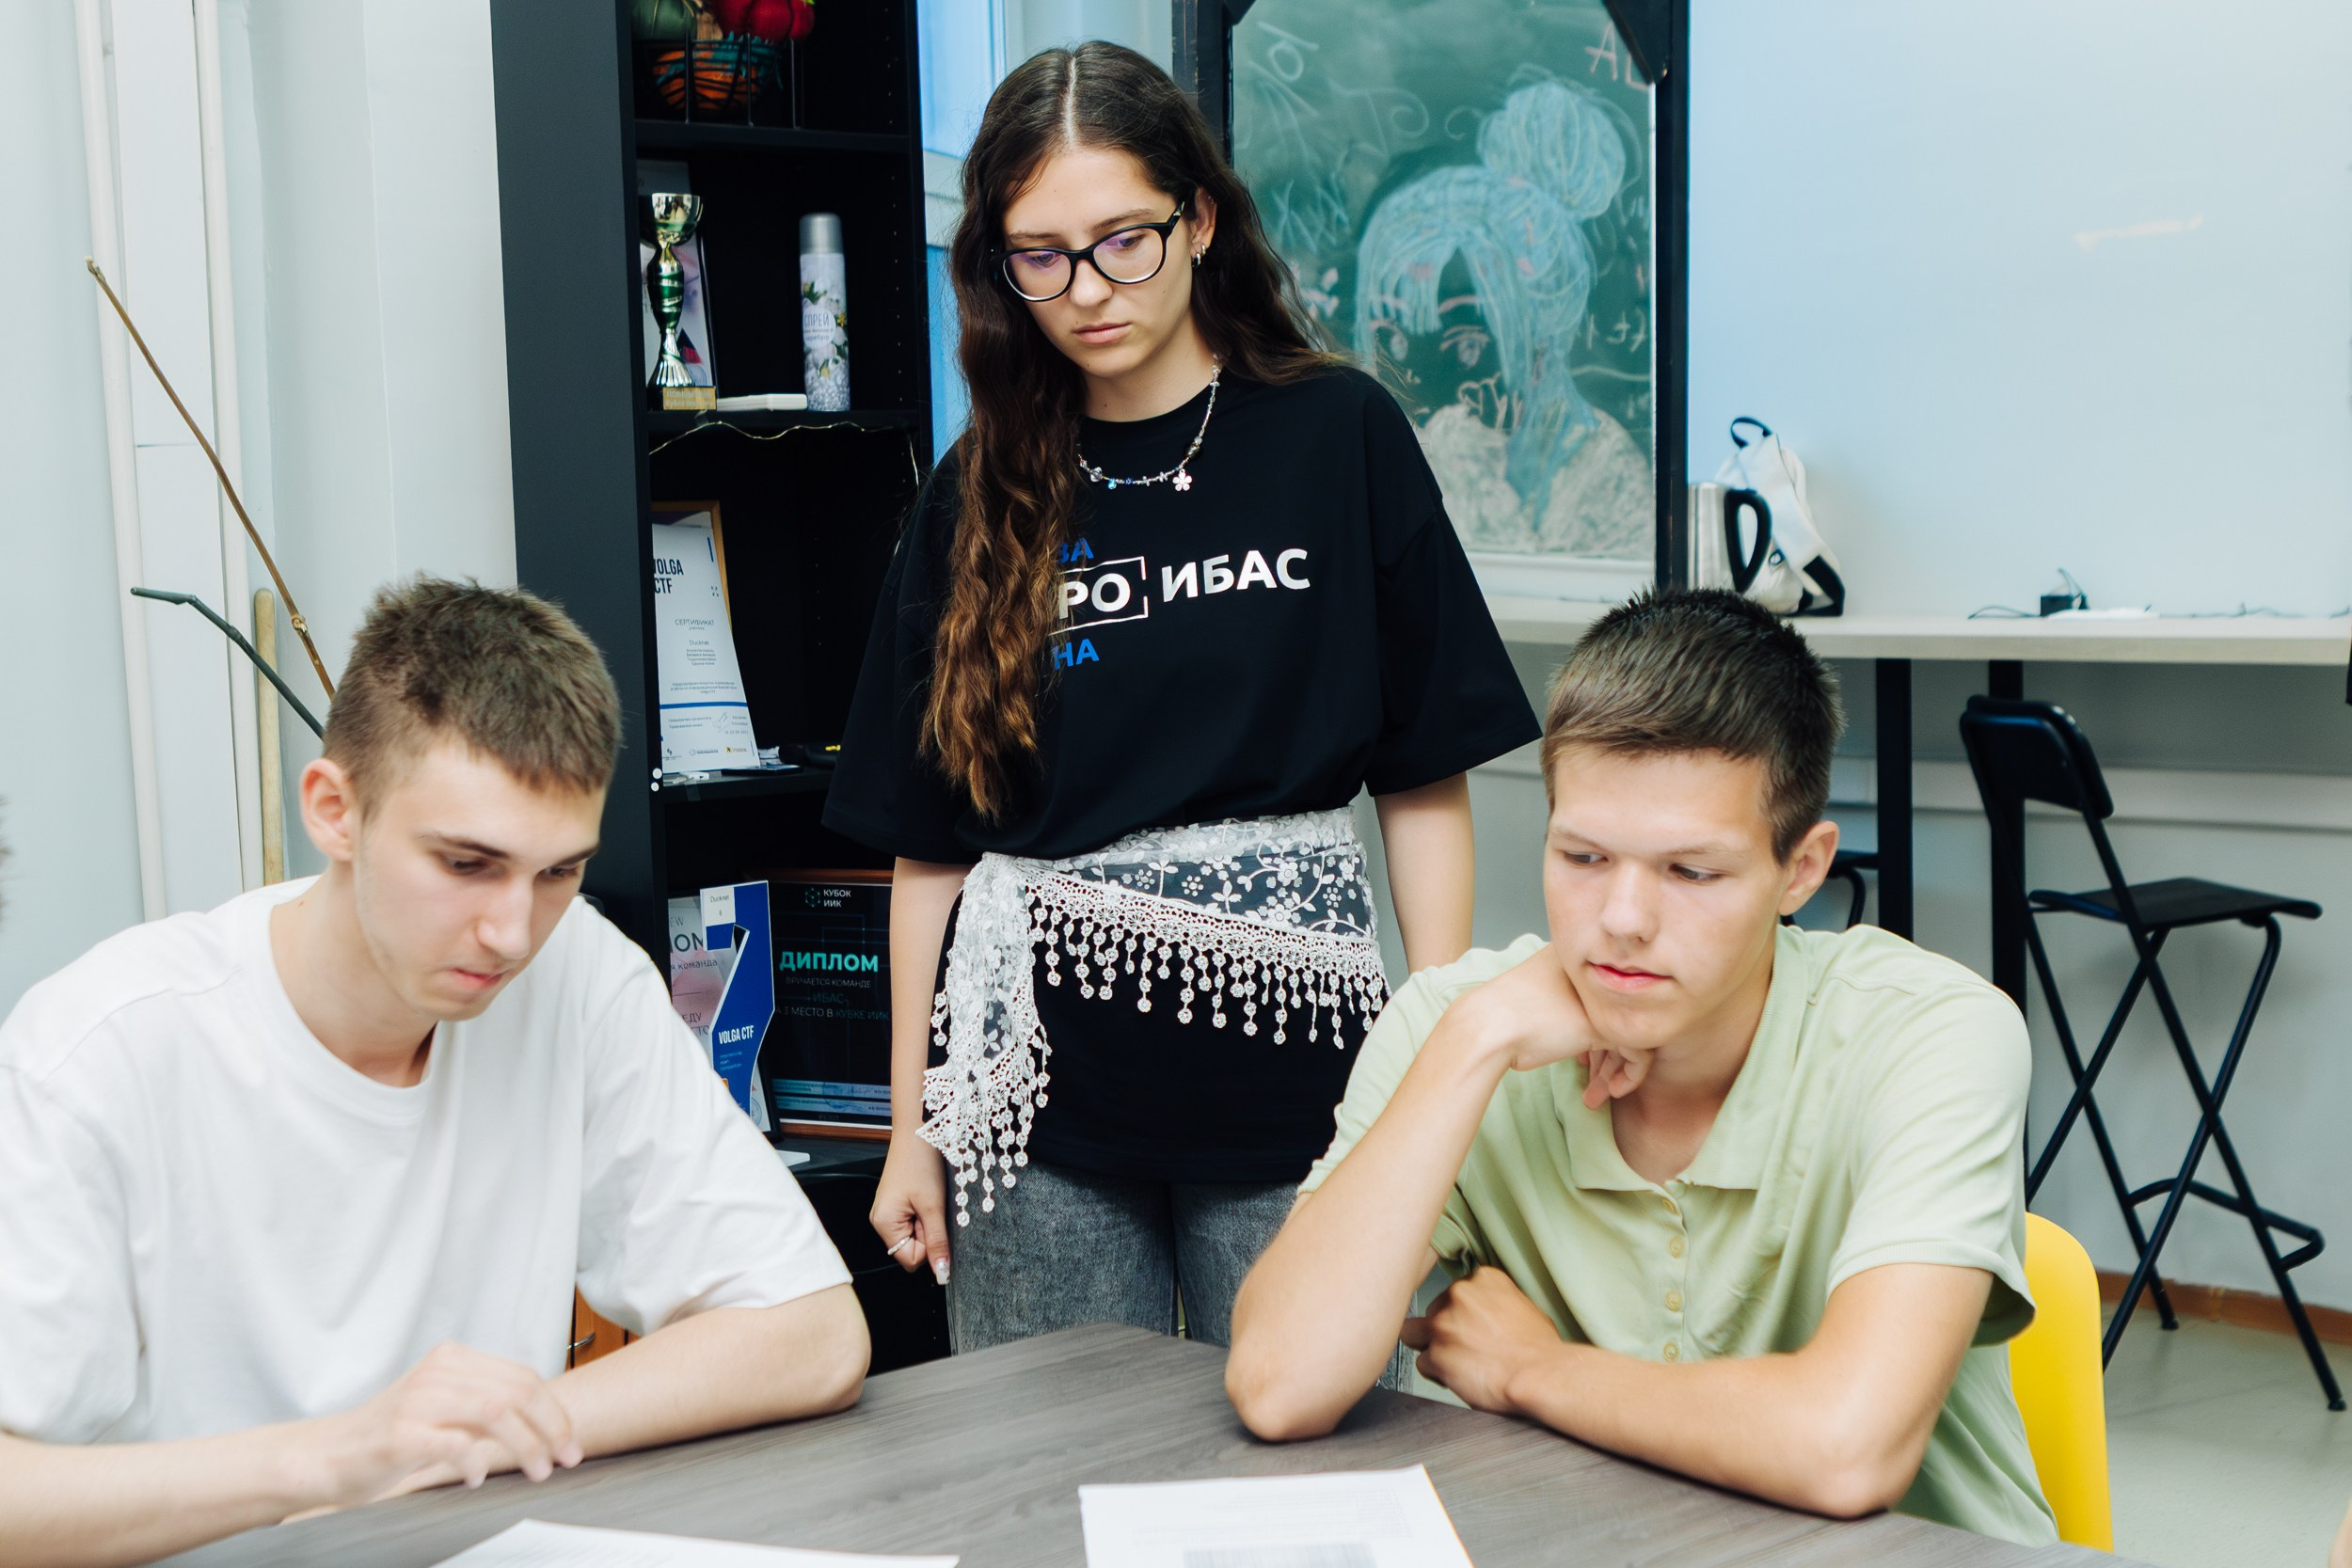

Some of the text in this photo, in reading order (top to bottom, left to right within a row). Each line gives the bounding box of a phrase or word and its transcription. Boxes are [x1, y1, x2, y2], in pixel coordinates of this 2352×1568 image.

[803, 312, 830, 327] СПРЕЙ
[1161, 548, 1311, 603] ИБАС
[1055, 639, 1100, 671] НА
[823, 889, 851, 898] КУБОК
[823, 899, 842, 908] ИИК
[678, 959, 718, 970] команда
[779, 951, 880, 973] ДИПЛОМ
[786, 976, 871, 989] ВРУЧАЕТСЯ КОМАНДЕ
[791, 1006, 825, 1017] МЕСТО
[718, 1024, 755, 1045] VOLGA CTF
